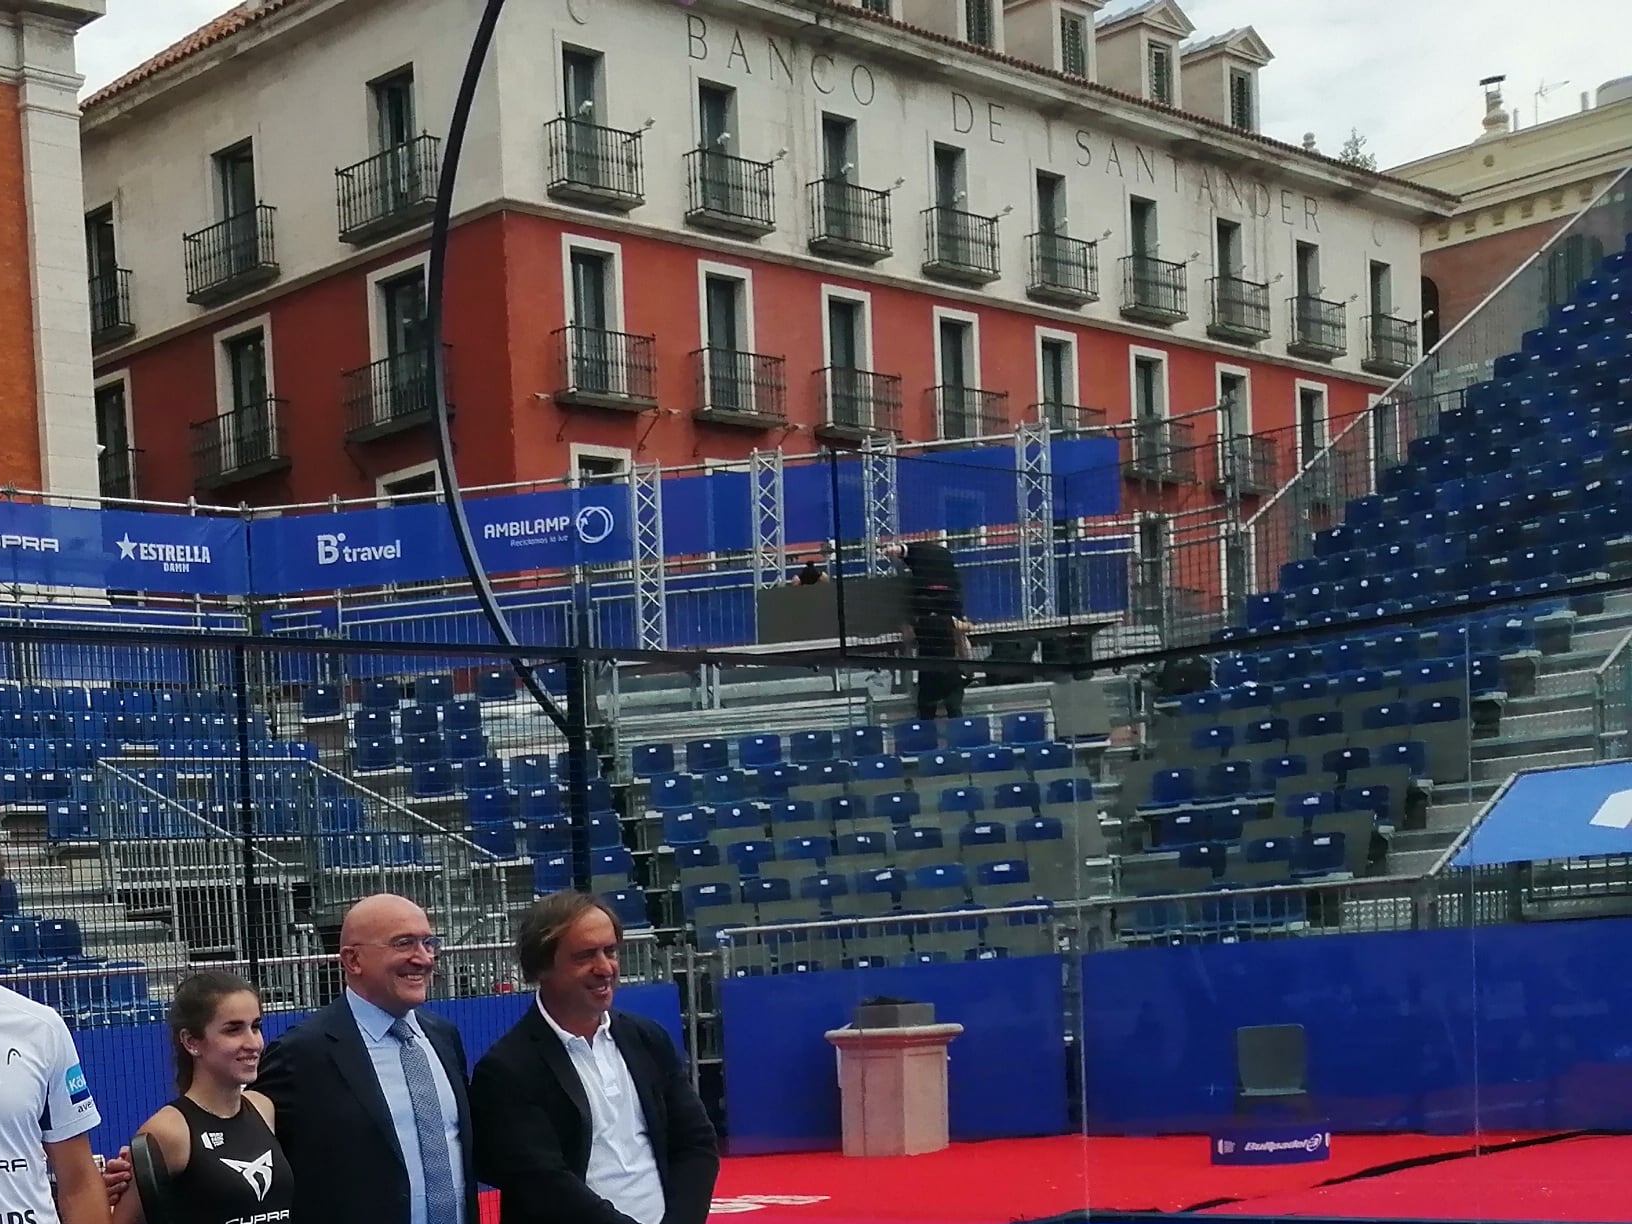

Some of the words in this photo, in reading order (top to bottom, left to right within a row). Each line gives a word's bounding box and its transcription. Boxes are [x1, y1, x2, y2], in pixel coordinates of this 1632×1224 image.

[686, 13, 876, 106] BANCO
[950, 90, 1007, 145] DE
[1074, 128, 1321, 234] SANTANDER
[483, 516, 571, 541] AMBILAMP
[139, 543, 212, 564] ESTRELLA
[343, 539, 402, 564] travel
